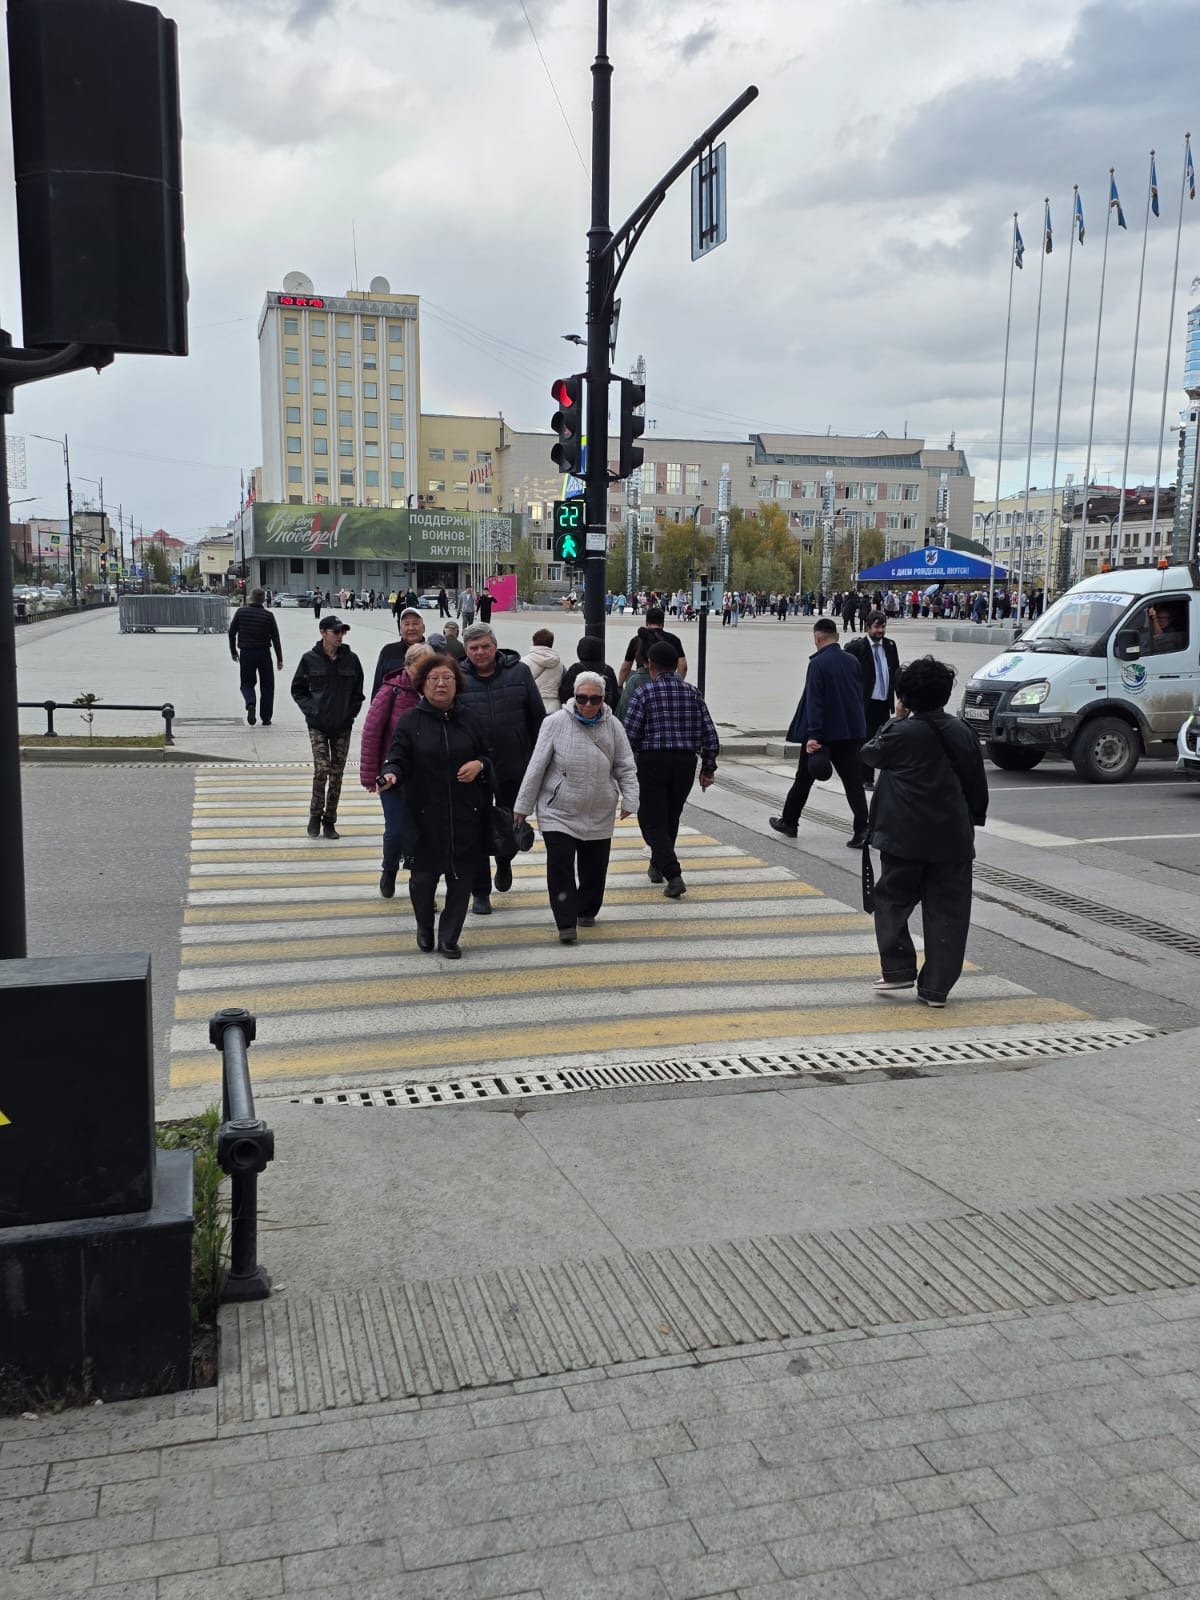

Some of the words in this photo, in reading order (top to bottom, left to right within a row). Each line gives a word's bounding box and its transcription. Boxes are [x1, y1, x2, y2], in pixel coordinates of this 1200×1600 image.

[409, 513, 472, 528] ПОДДЕРЖИ
[559, 506, 578, 526] 22
[422, 529, 471, 541] ВОИНОВ-
[430, 545, 471, 556] ЯКУТЯН
